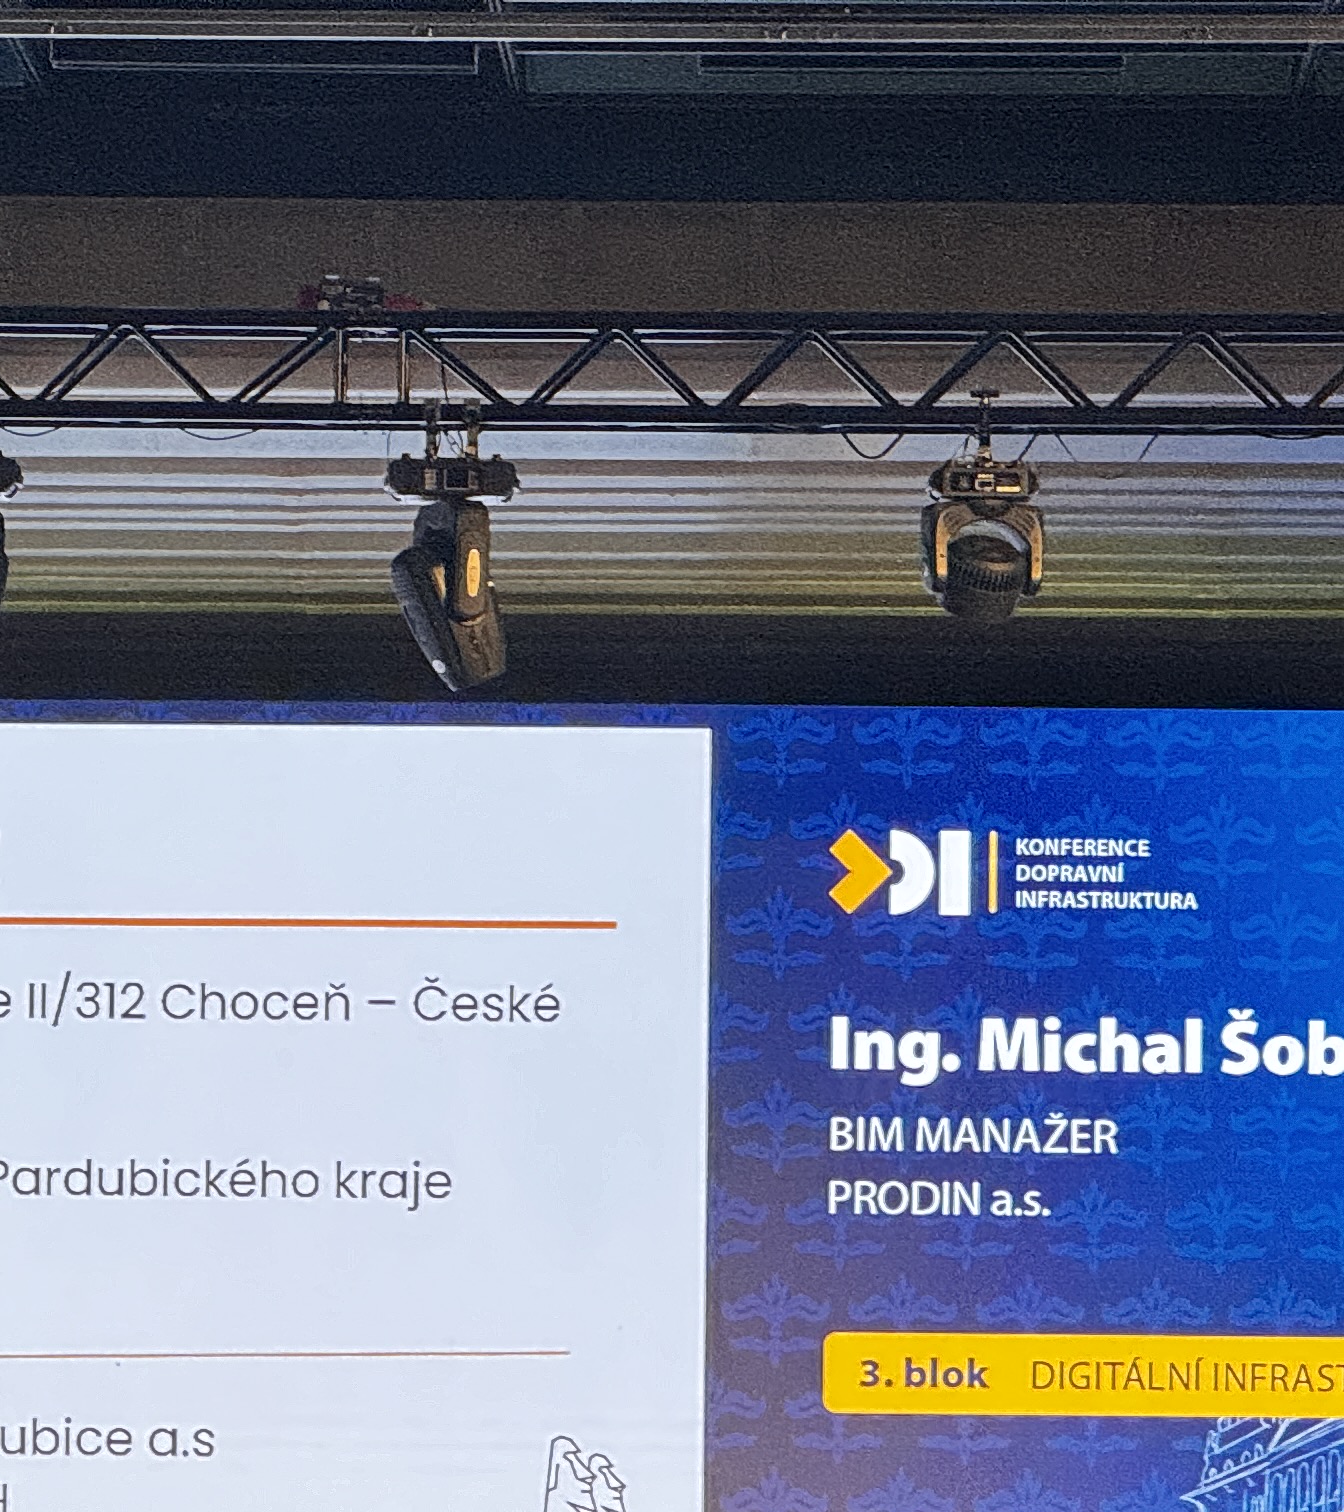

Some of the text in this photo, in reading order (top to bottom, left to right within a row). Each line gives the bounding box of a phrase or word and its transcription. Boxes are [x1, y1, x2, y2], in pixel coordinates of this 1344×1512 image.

[1015, 837, 1151, 857] KONFERENCE
[1015, 862, 1124, 883] DOPRAVNÍ
[1015, 889, 1198, 910] INFRASTRUKTURA
[28, 970, 147, 1028] II/312
[161, 982, 350, 1022] Choceň
[413, 976, 561, 1023] České
[830, 1015, 962, 1087] Ing.
[977, 1015, 1203, 1075] Michal
[829, 1112, 1119, 1155] BIM MANAŽER
[335, 1160, 452, 1212] kraje
[827, 1179, 1052, 1217] PRODIN a.s.
[859, 1359, 894, 1388] 3.
[904, 1356, 990, 1389] blok
[1032, 1356, 1204, 1391] DIGITÁLNÍ
[148, 1428, 215, 1458] a.s
